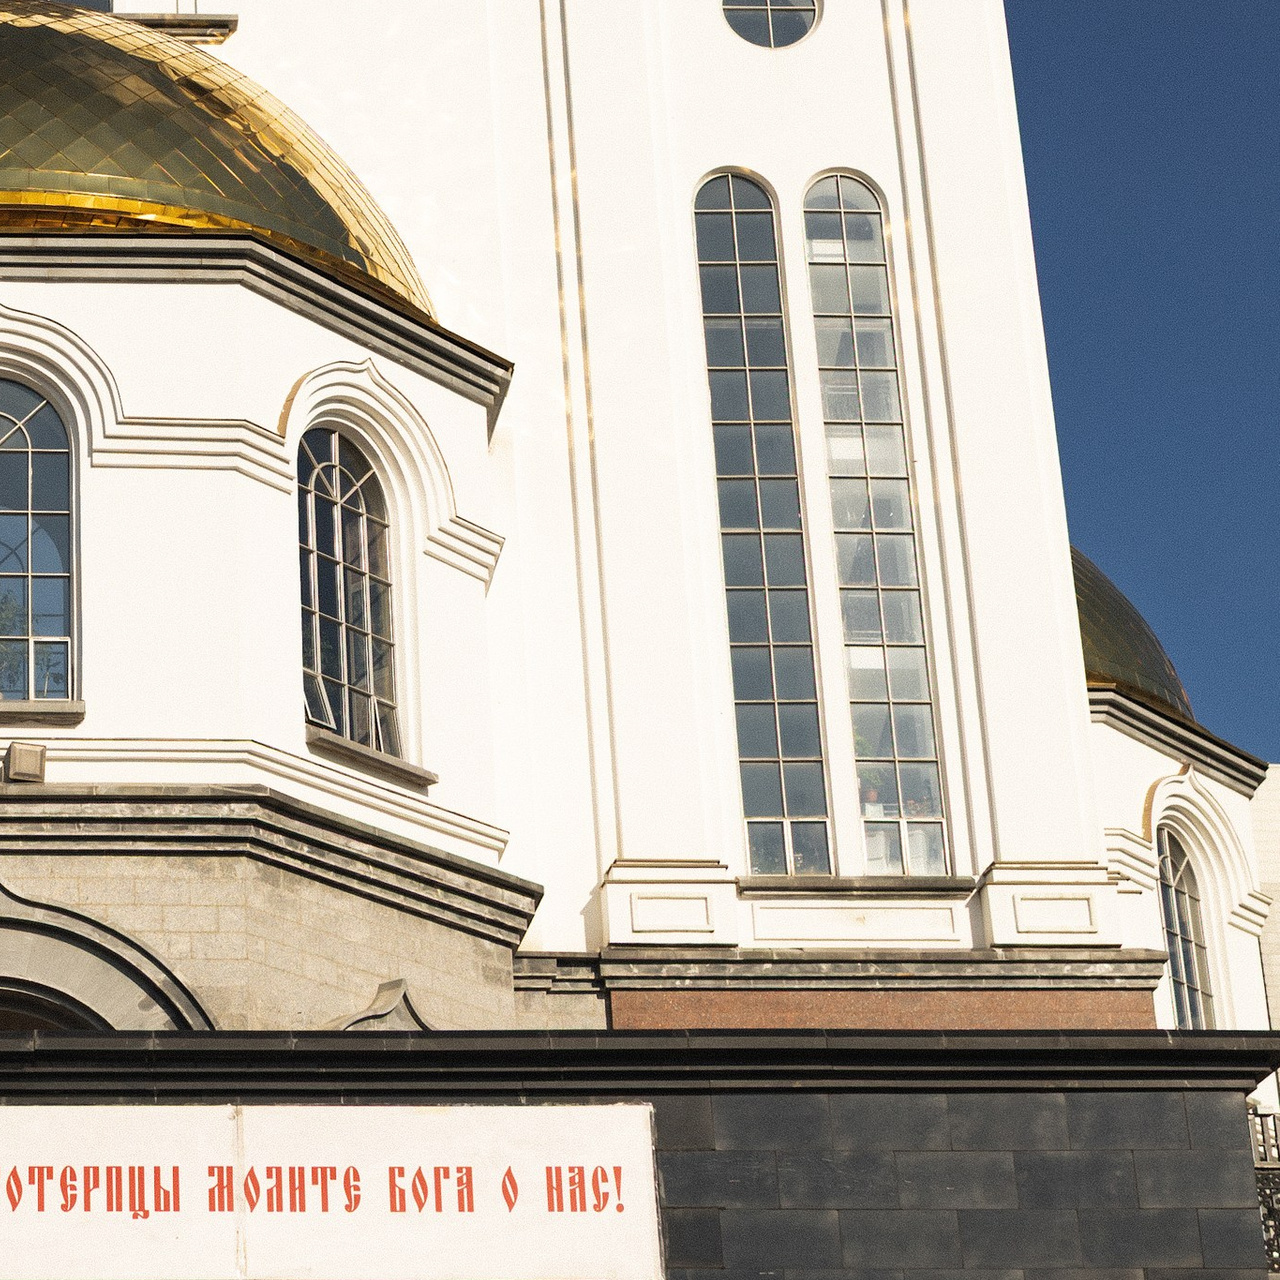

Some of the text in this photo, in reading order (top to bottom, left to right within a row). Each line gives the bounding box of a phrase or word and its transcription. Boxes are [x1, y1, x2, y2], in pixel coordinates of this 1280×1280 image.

[207, 1165, 361, 1213] МОЛИТЕ
[388, 1166, 475, 1213] БОГА
[501, 1166, 519, 1212] О
[545, 1165, 625, 1213] НАС!
